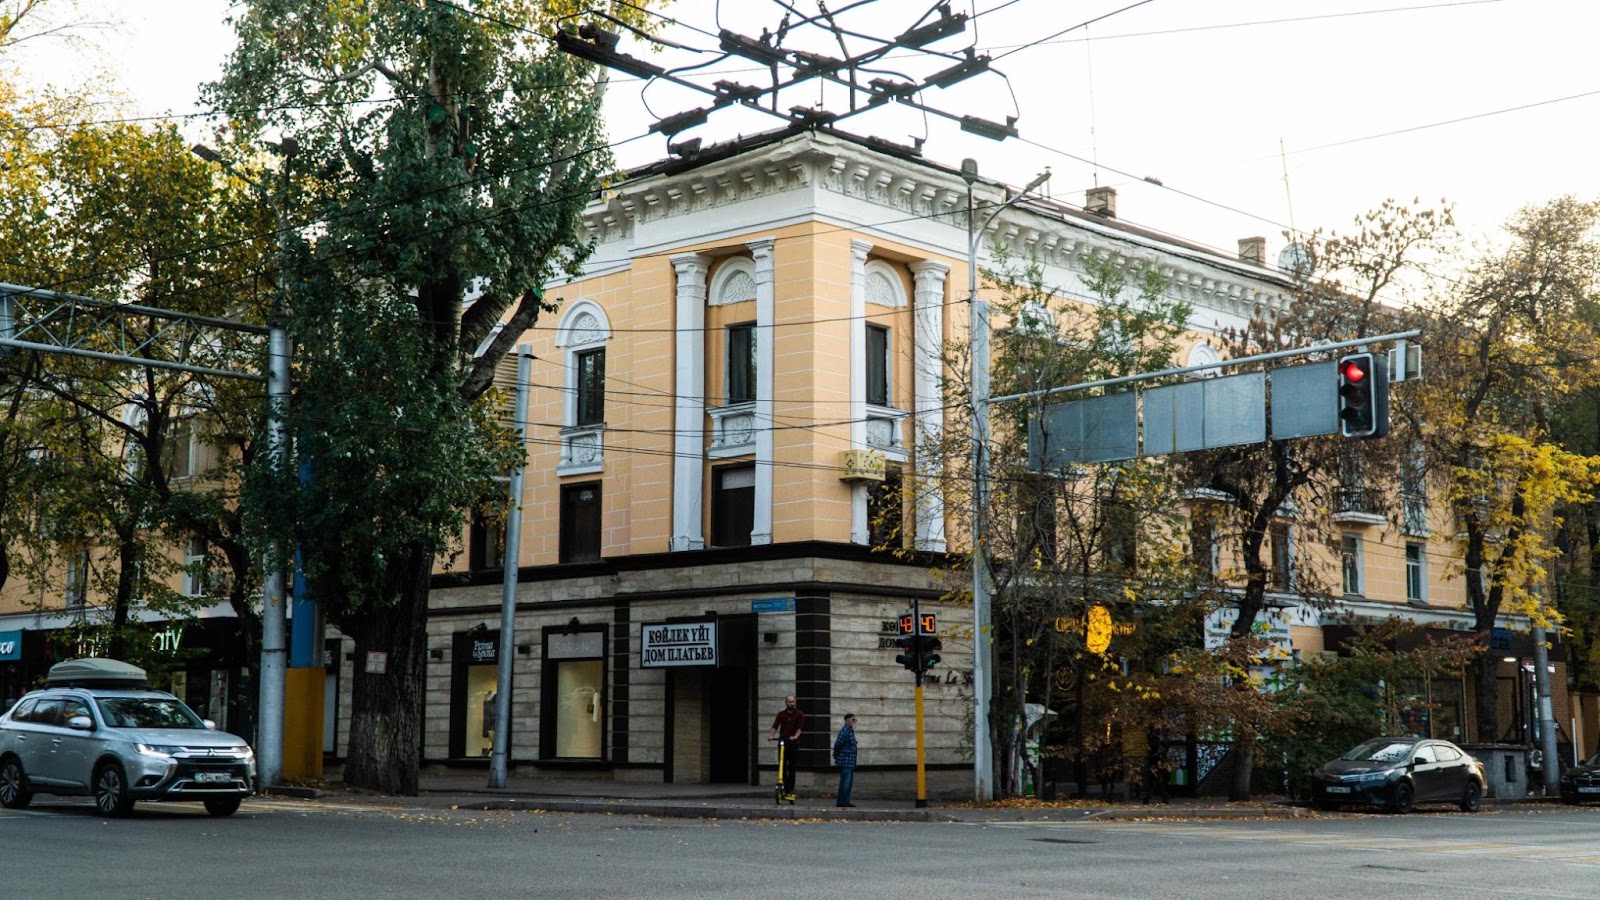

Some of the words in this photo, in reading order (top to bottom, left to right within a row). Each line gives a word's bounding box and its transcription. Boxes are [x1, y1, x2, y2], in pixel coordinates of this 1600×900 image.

[920, 616, 935, 632] 40
[648, 626, 690, 644] КӨЙЛЕК
[691, 625, 710, 642] ҮЙІ
[644, 650, 666, 664] ДОМ
[668, 646, 714, 662] ПЛАТЬЕВ
